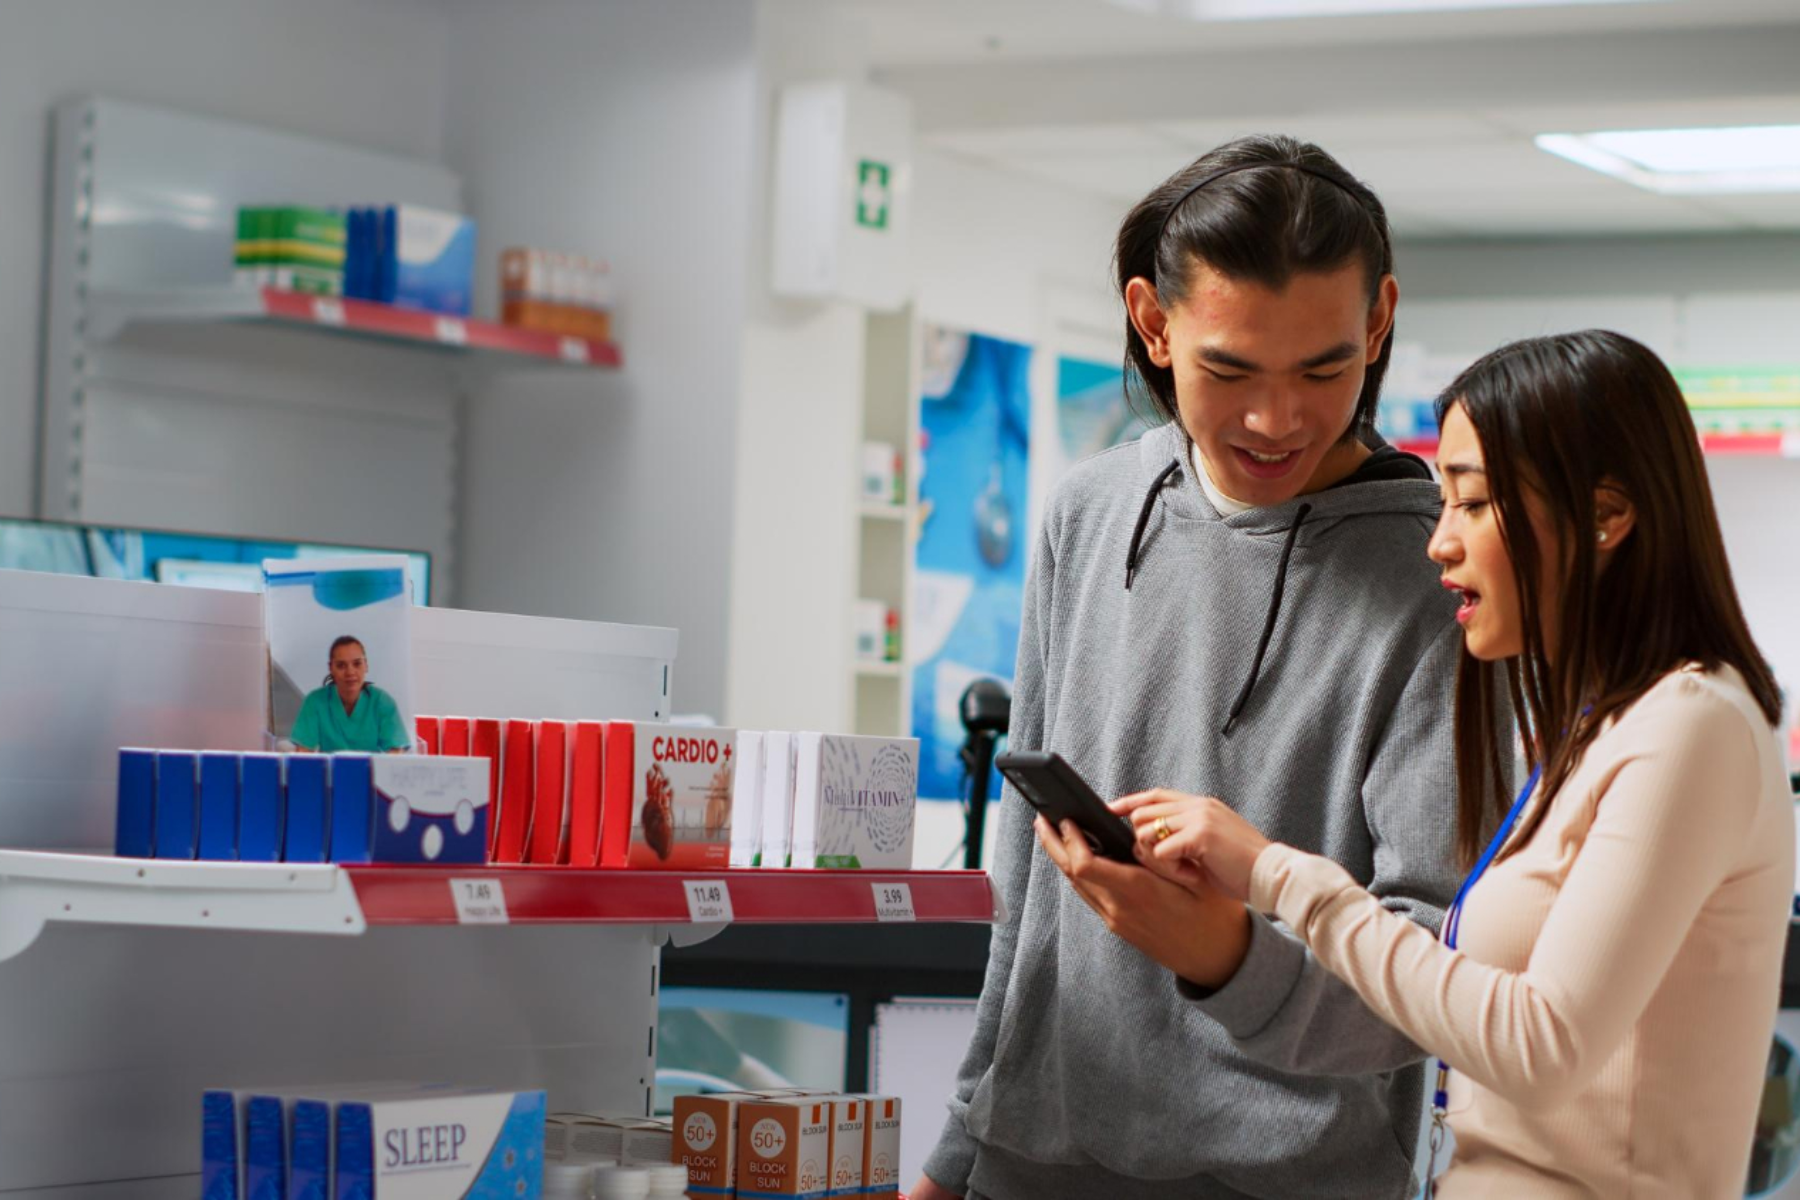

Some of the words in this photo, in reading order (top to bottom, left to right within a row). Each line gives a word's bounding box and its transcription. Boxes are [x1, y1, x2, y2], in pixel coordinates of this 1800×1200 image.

[652, 735, 719, 764] CARDIO
[464, 883, 491, 900] 7.49
[693, 886, 722, 902] 11.49
[883, 888, 903, 904] 3.99
[384, 1123, 467, 1168] SLEEP
[682, 1155, 717, 1168] BLOCK
[749, 1161, 786, 1174] BLOCK
[689, 1169, 711, 1182] SUN
[757, 1176, 780, 1189] SUN
